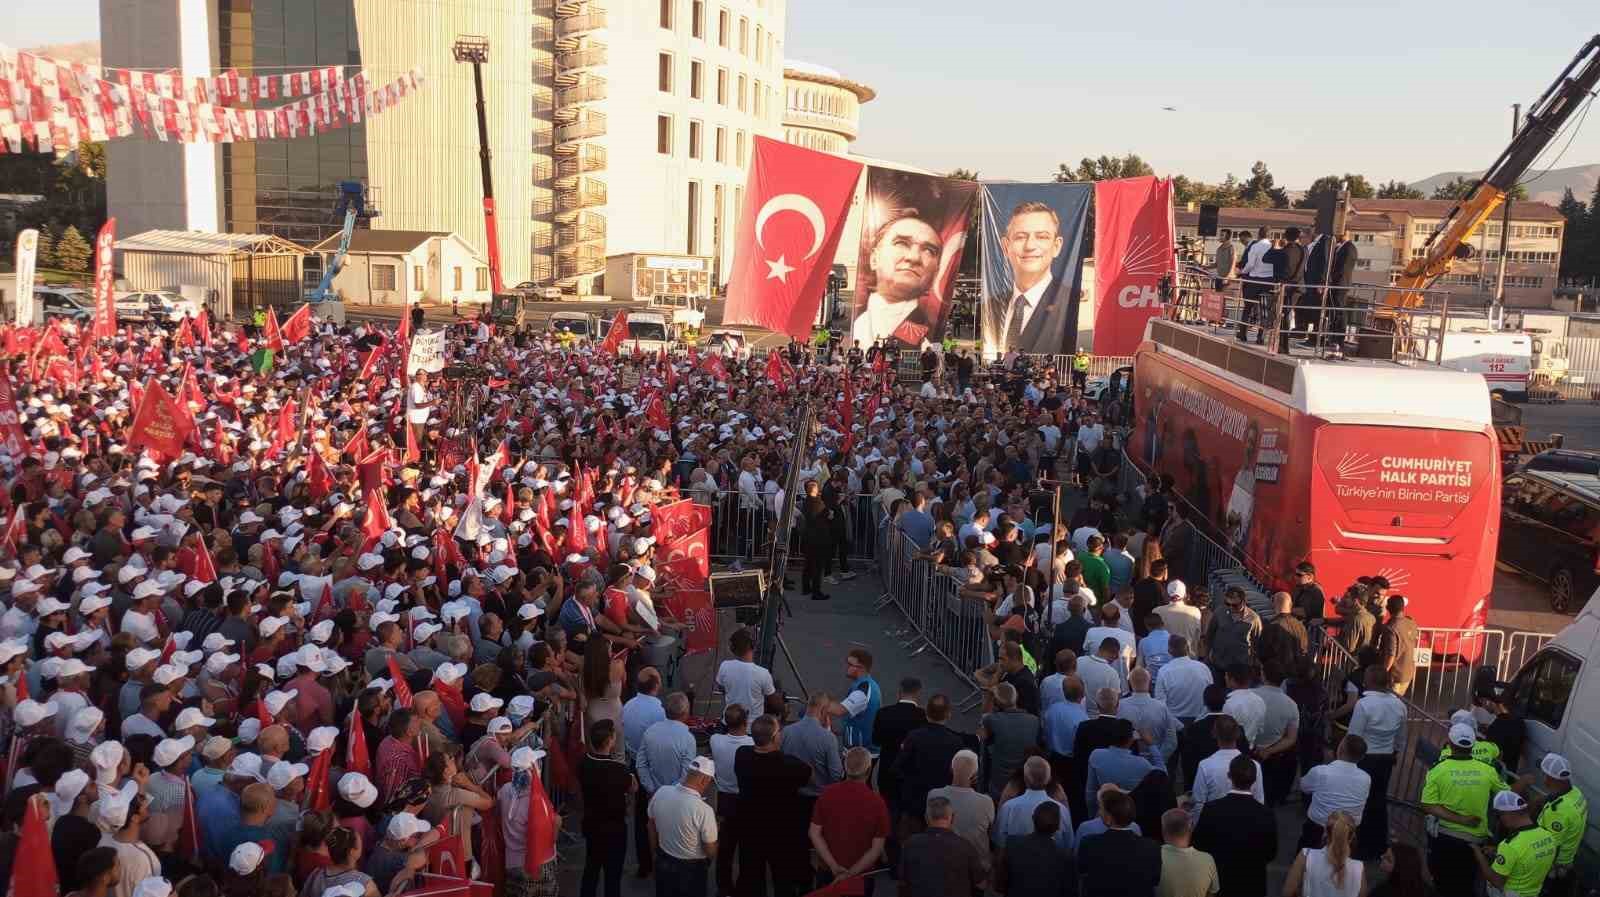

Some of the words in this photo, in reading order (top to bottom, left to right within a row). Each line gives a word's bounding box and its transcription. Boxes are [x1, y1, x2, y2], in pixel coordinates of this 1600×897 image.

[1118, 285, 1164, 308] CH
[1381, 456, 1472, 472] CUMHURİYET
[1380, 471, 1416, 484] HALK
[1420, 472, 1471, 487] PARTİSİ
[1336, 484, 1396, 499] Türkiye'nin
[1398, 487, 1432, 501] Birinci
[1435, 490, 1470, 504] Partisi
